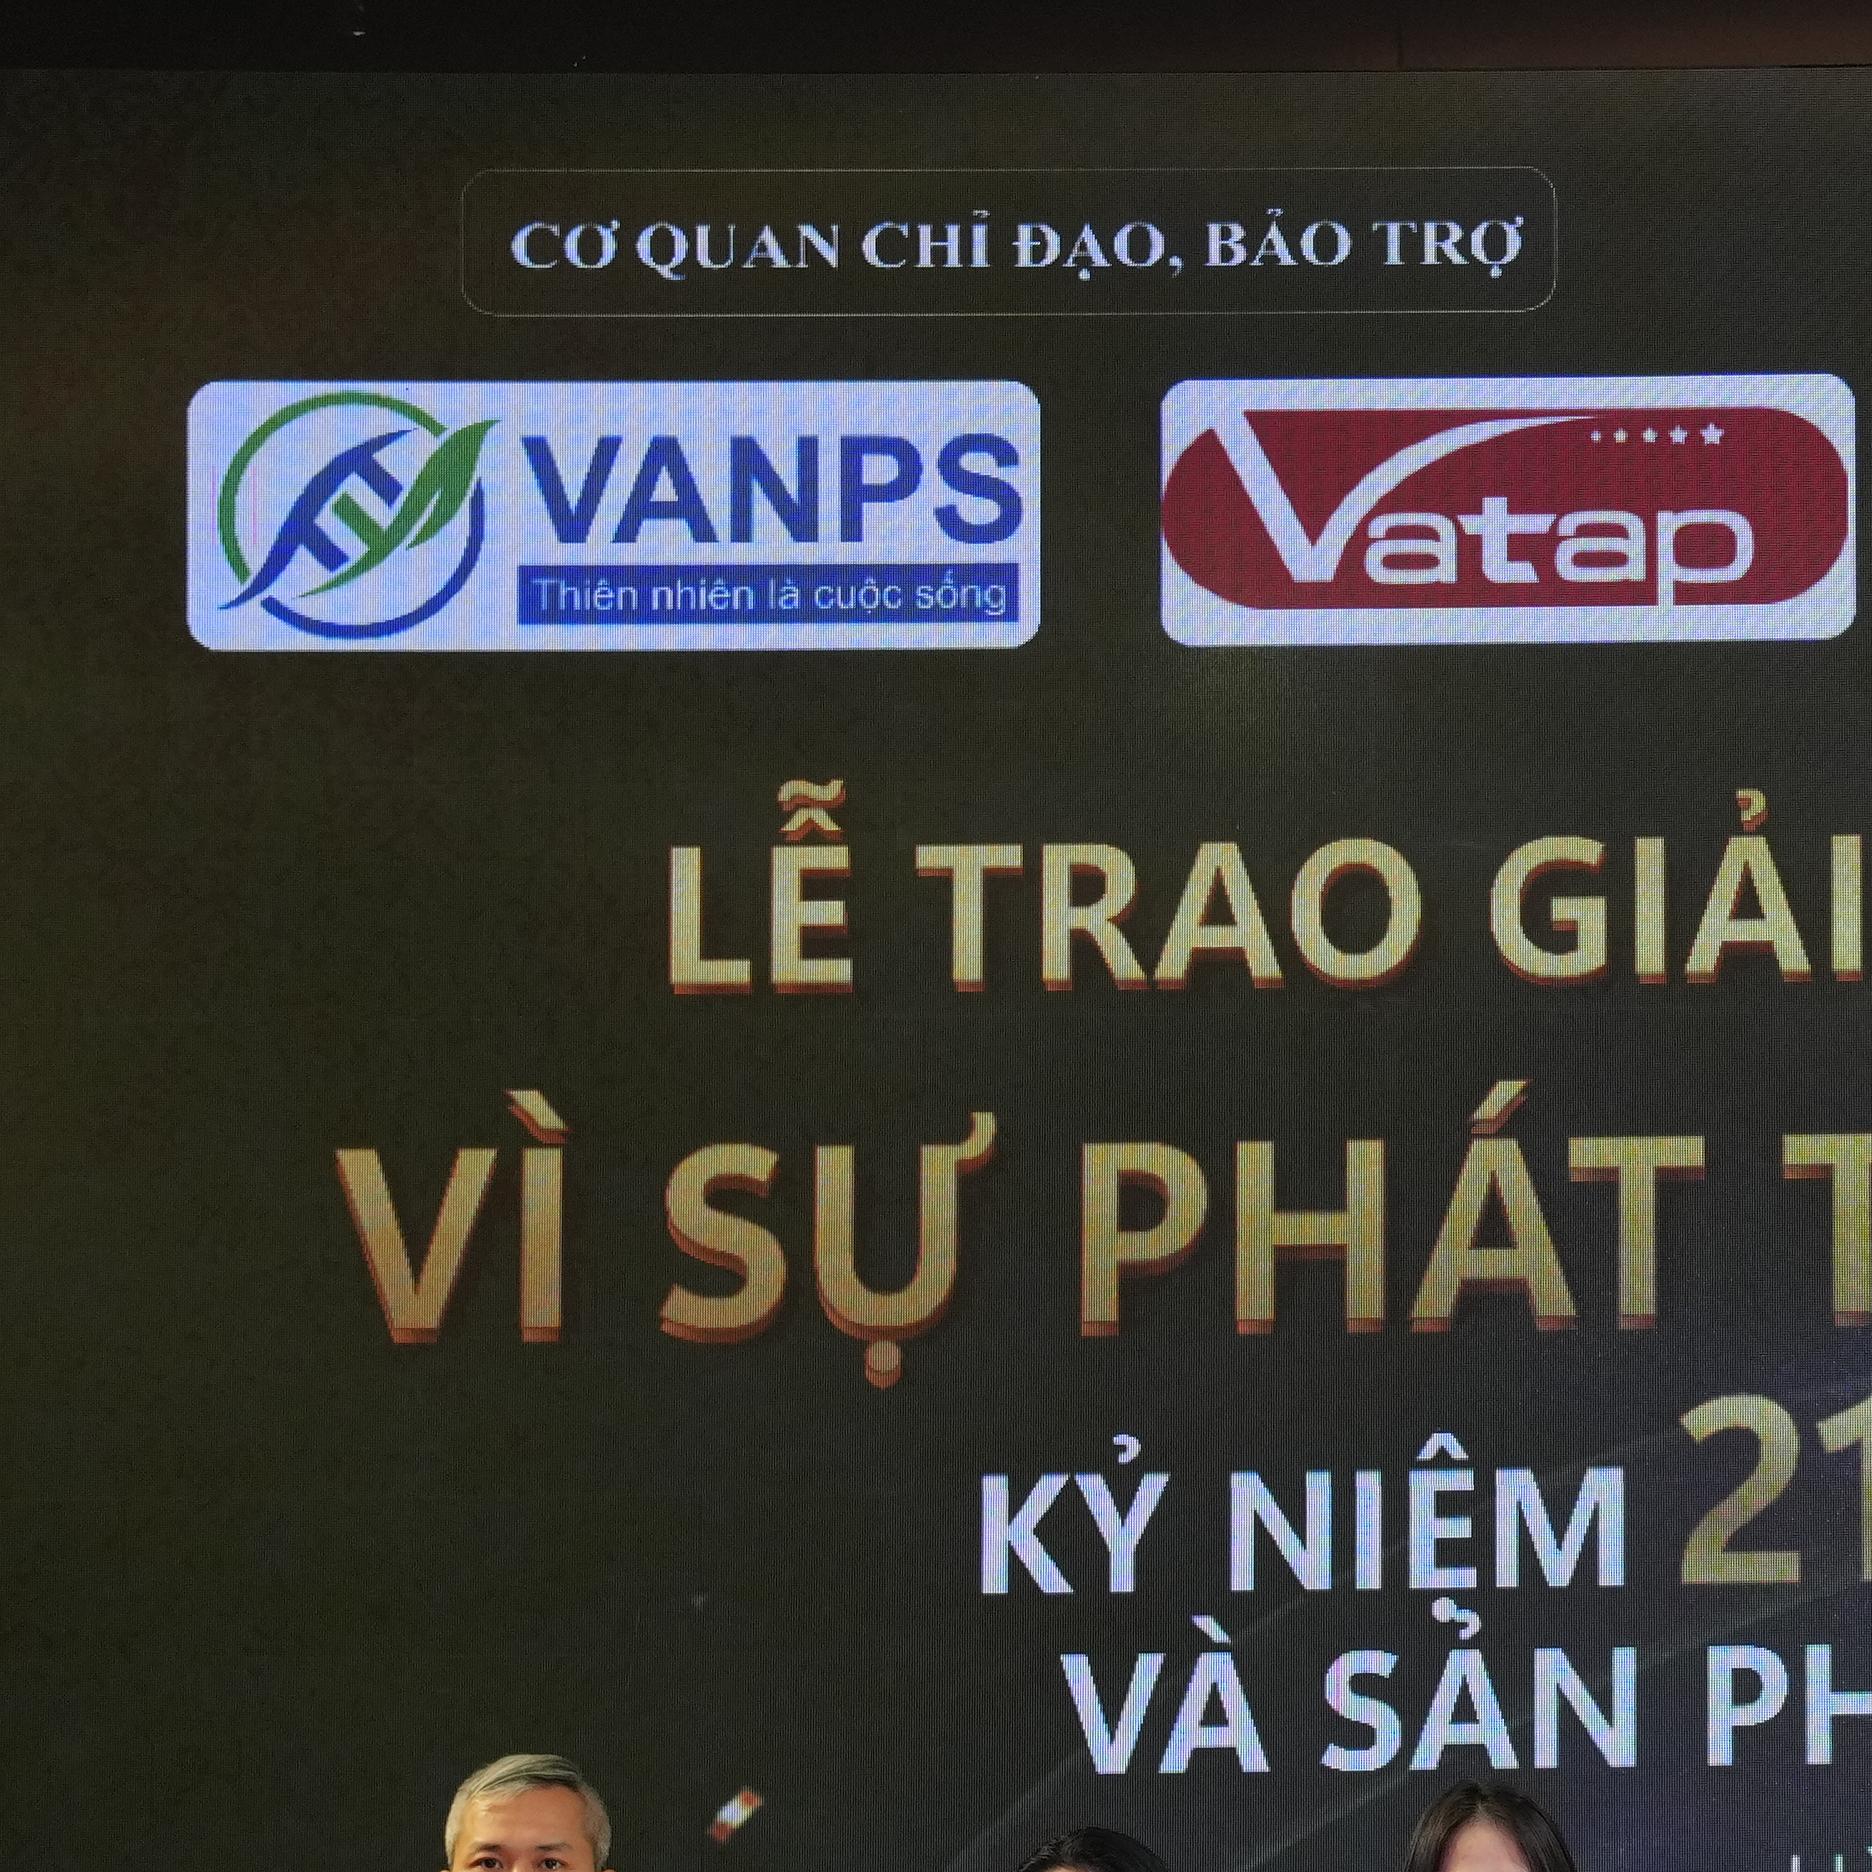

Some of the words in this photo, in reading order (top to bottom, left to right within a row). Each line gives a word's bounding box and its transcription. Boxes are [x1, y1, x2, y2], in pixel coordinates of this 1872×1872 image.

[510, 220, 621, 267] CƠ
[636, 224, 838, 279] QUAN
[861, 208, 988, 268] CHỈ
[1014, 223, 1182, 280] ĐẠO,
[1206, 206, 1352, 267] BẢO
[1374, 216, 1523, 277] TRỢ
[520, 432, 1024, 545] VANPS
[1205, 408, 1755, 606] Vatap
[532, 576, 638, 611] Thiên
[650, 576, 755, 611] nhiên
[768, 575, 800, 610] là
[813, 576, 903, 615] cuộc
[914, 568, 1008, 616] sống
[669, 779, 853, 994] LỄ
[915, 837, 1422, 991] TRAO
[1489, 789, 1863, 983] GIẢI
[334, 1088, 571, 1343] VÌ
[662, 1112, 996, 1386] SỰ
[1081, 1079, 1705, 1335] PHÁT
[980, 1432, 1169, 1595] KỶ
[1229, 1431, 1626, 1622] NIỆM
[1061, 1614, 1269, 1775] VÀ
[1321, 1606, 1638, 1773] SẢN
